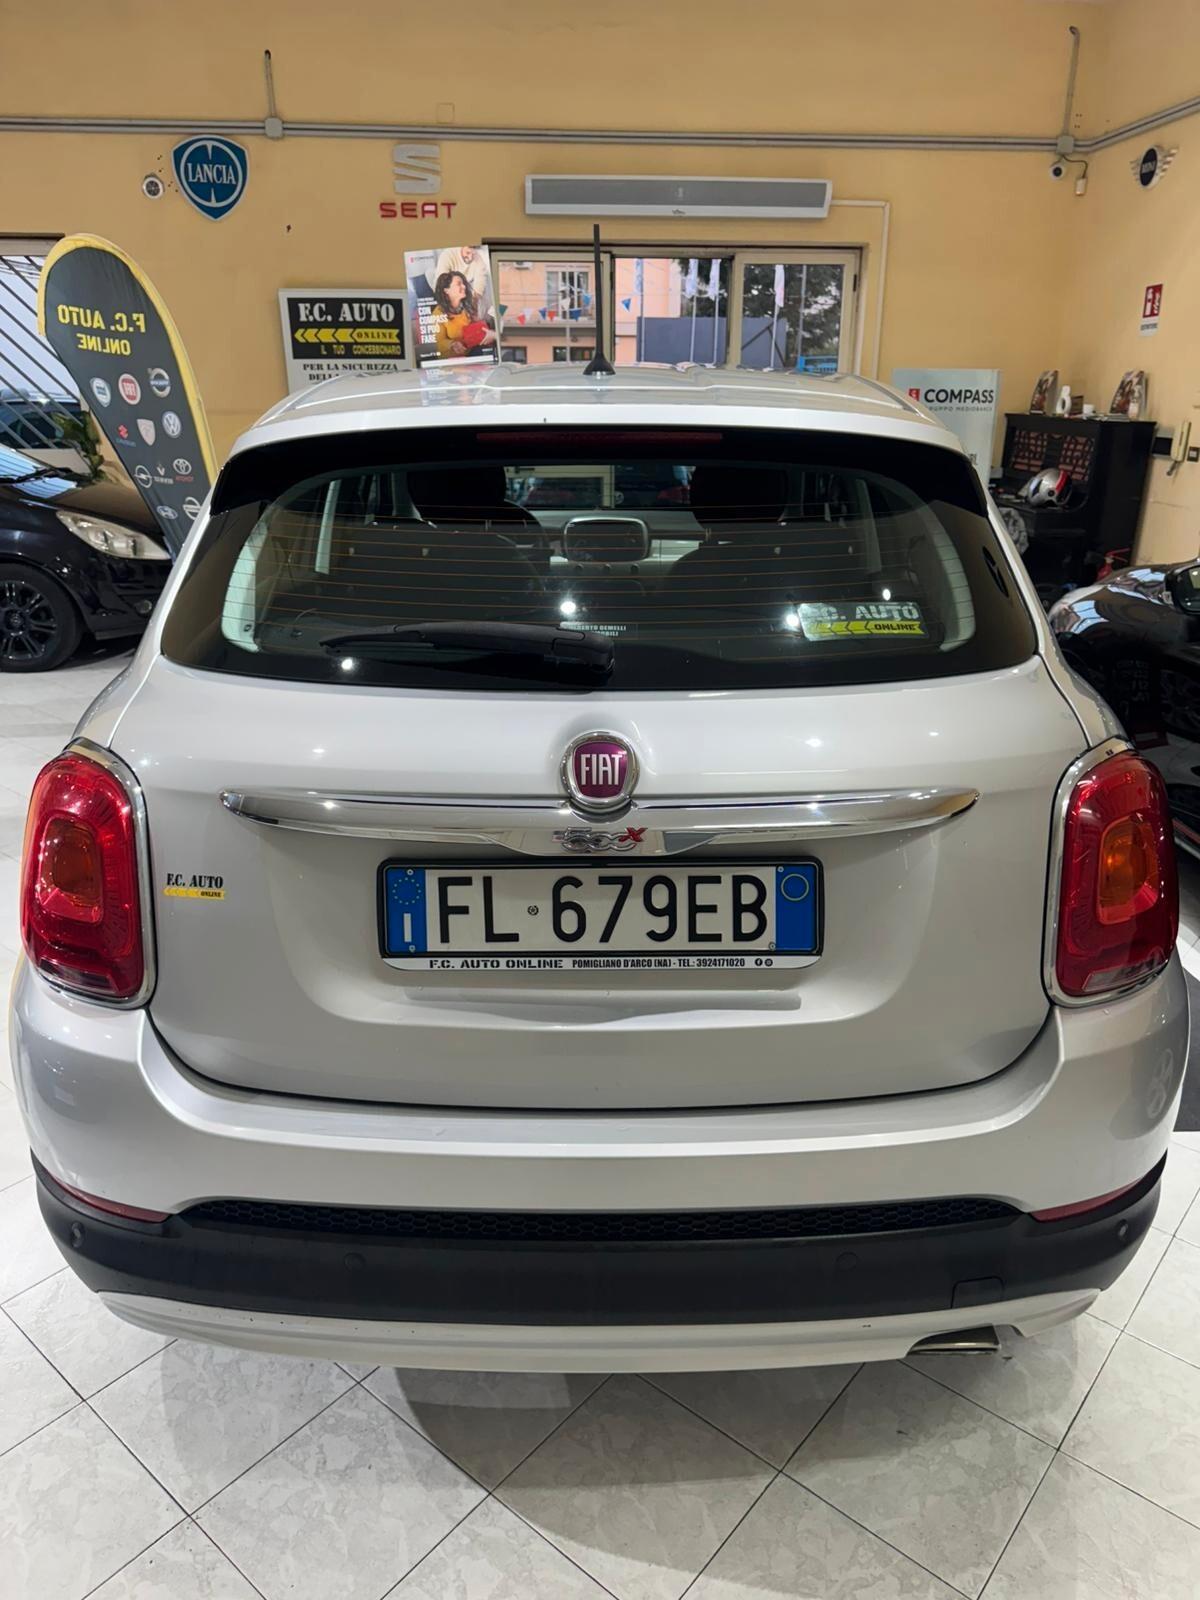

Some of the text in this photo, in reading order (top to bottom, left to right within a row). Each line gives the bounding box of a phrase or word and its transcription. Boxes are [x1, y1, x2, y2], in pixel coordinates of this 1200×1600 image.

[187, 163, 236, 184] LANCIA
[379, 202, 457, 218] SEAT
[298, 303, 395, 322] F.C. AUTO
[303, 363, 398, 372] PER LA SICUREZZA
[924, 388, 994, 404] COMPASS
[855, 604, 919, 621] AUTO
[874, 623, 917, 631] ONLINE
[580, 754, 623, 785] FIAT
[167, 873, 224, 889] F.C. AUTO
[200, 890, 222, 898] ONLINE
[437, 874, 768, 944] FL 679EB
[429, 959, 455, 969] F.C.
[460, 959, 501, 969] AUTO
[505, 959, 563, 969] ONLINE
[572, 959, 622, 968] POMIGLIANO
[623, 958, 653, 968] D'ARCO
[654, 958, 672, 968] (NA)
[696, 957, 746, 968] 3924171020
